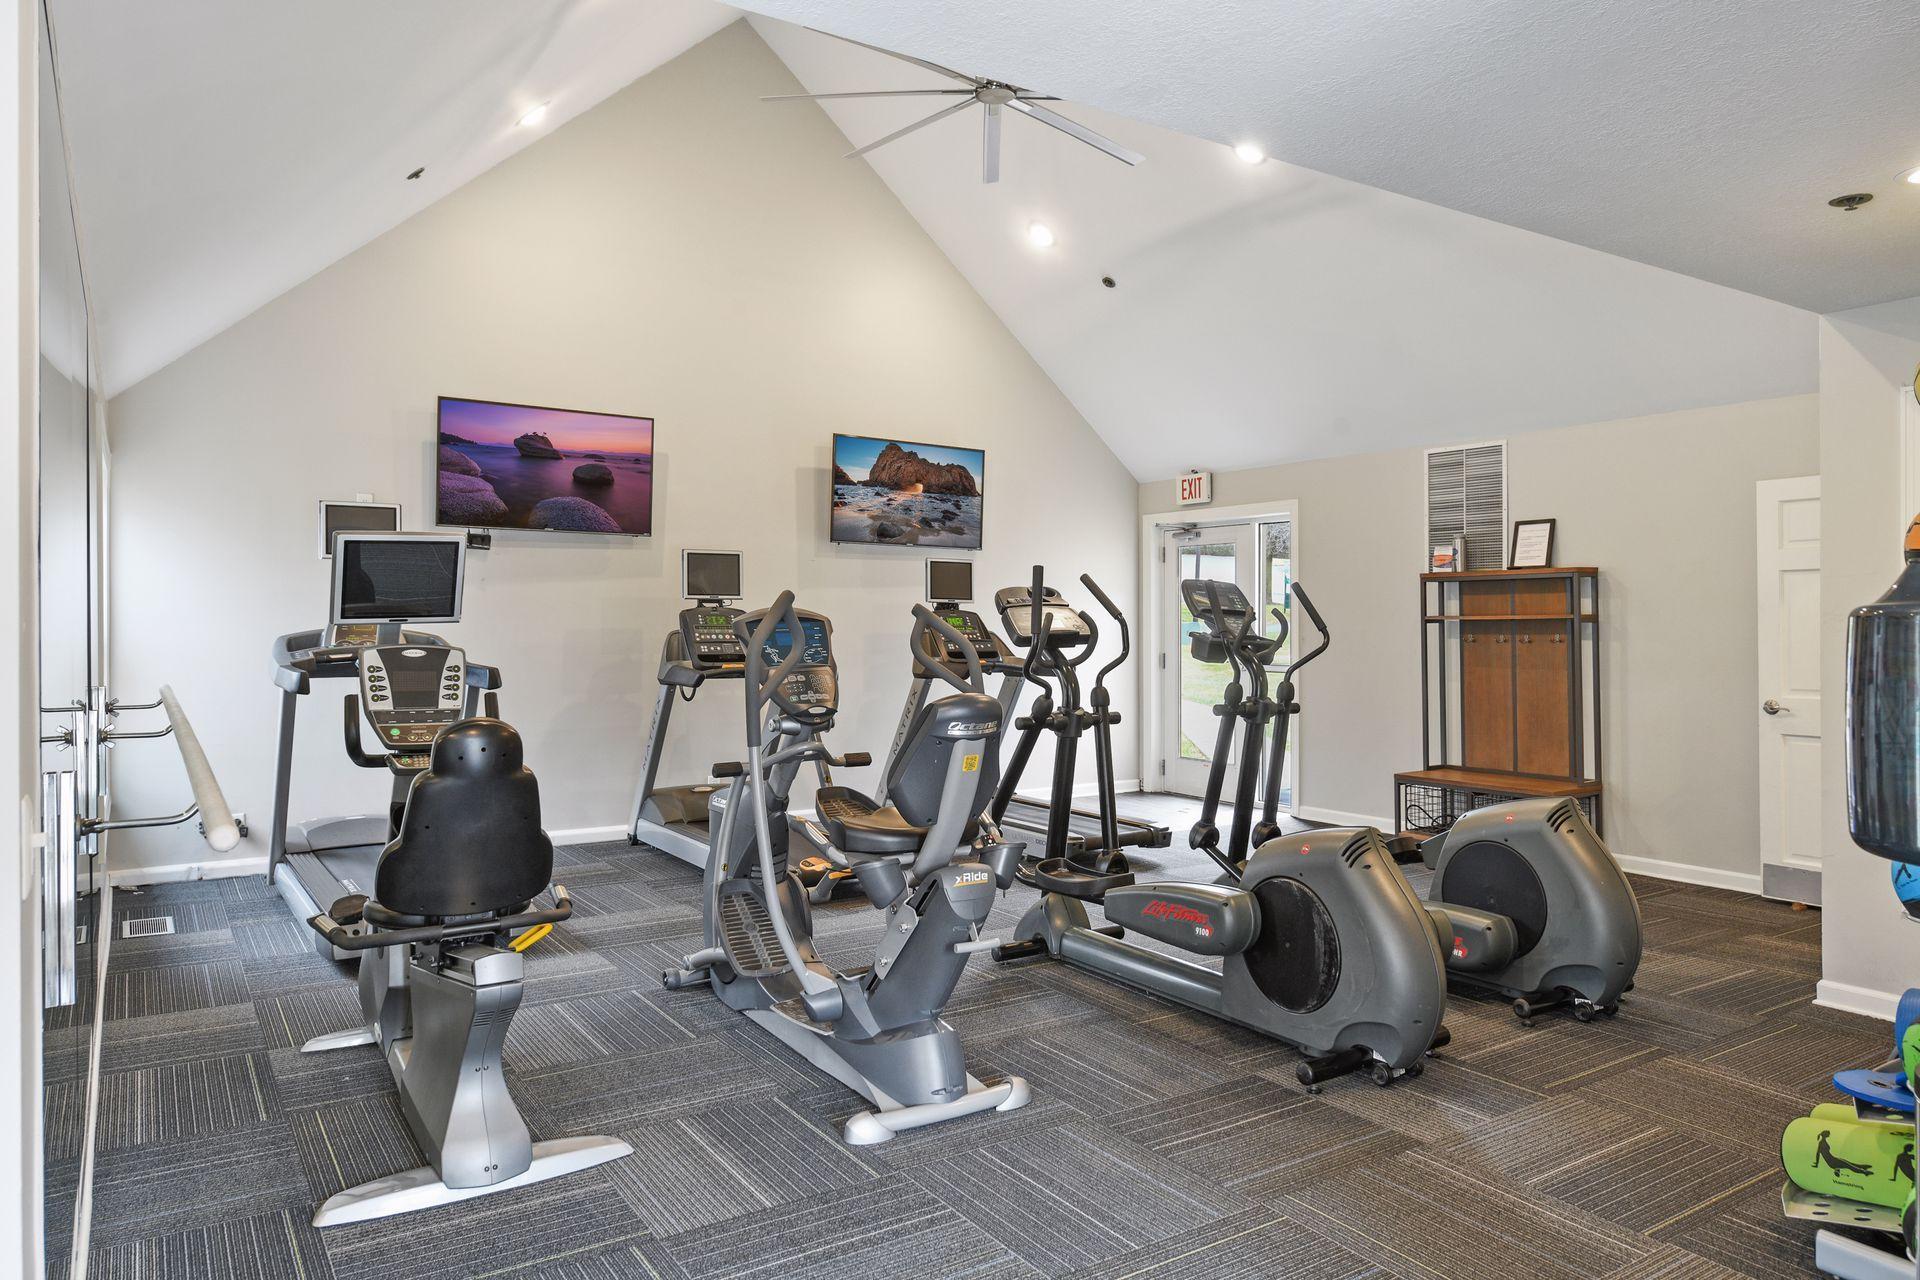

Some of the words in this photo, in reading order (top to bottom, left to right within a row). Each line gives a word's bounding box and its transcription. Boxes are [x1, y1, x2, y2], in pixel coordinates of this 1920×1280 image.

[1181, 477, 1202, 500] EXIT
[892, 688, 918, 756] MATRIX
[947, 720, 998, 731] Octane
[955, 871, 988, 884] xRide
[1195, 926, 1210, 937] 9100
